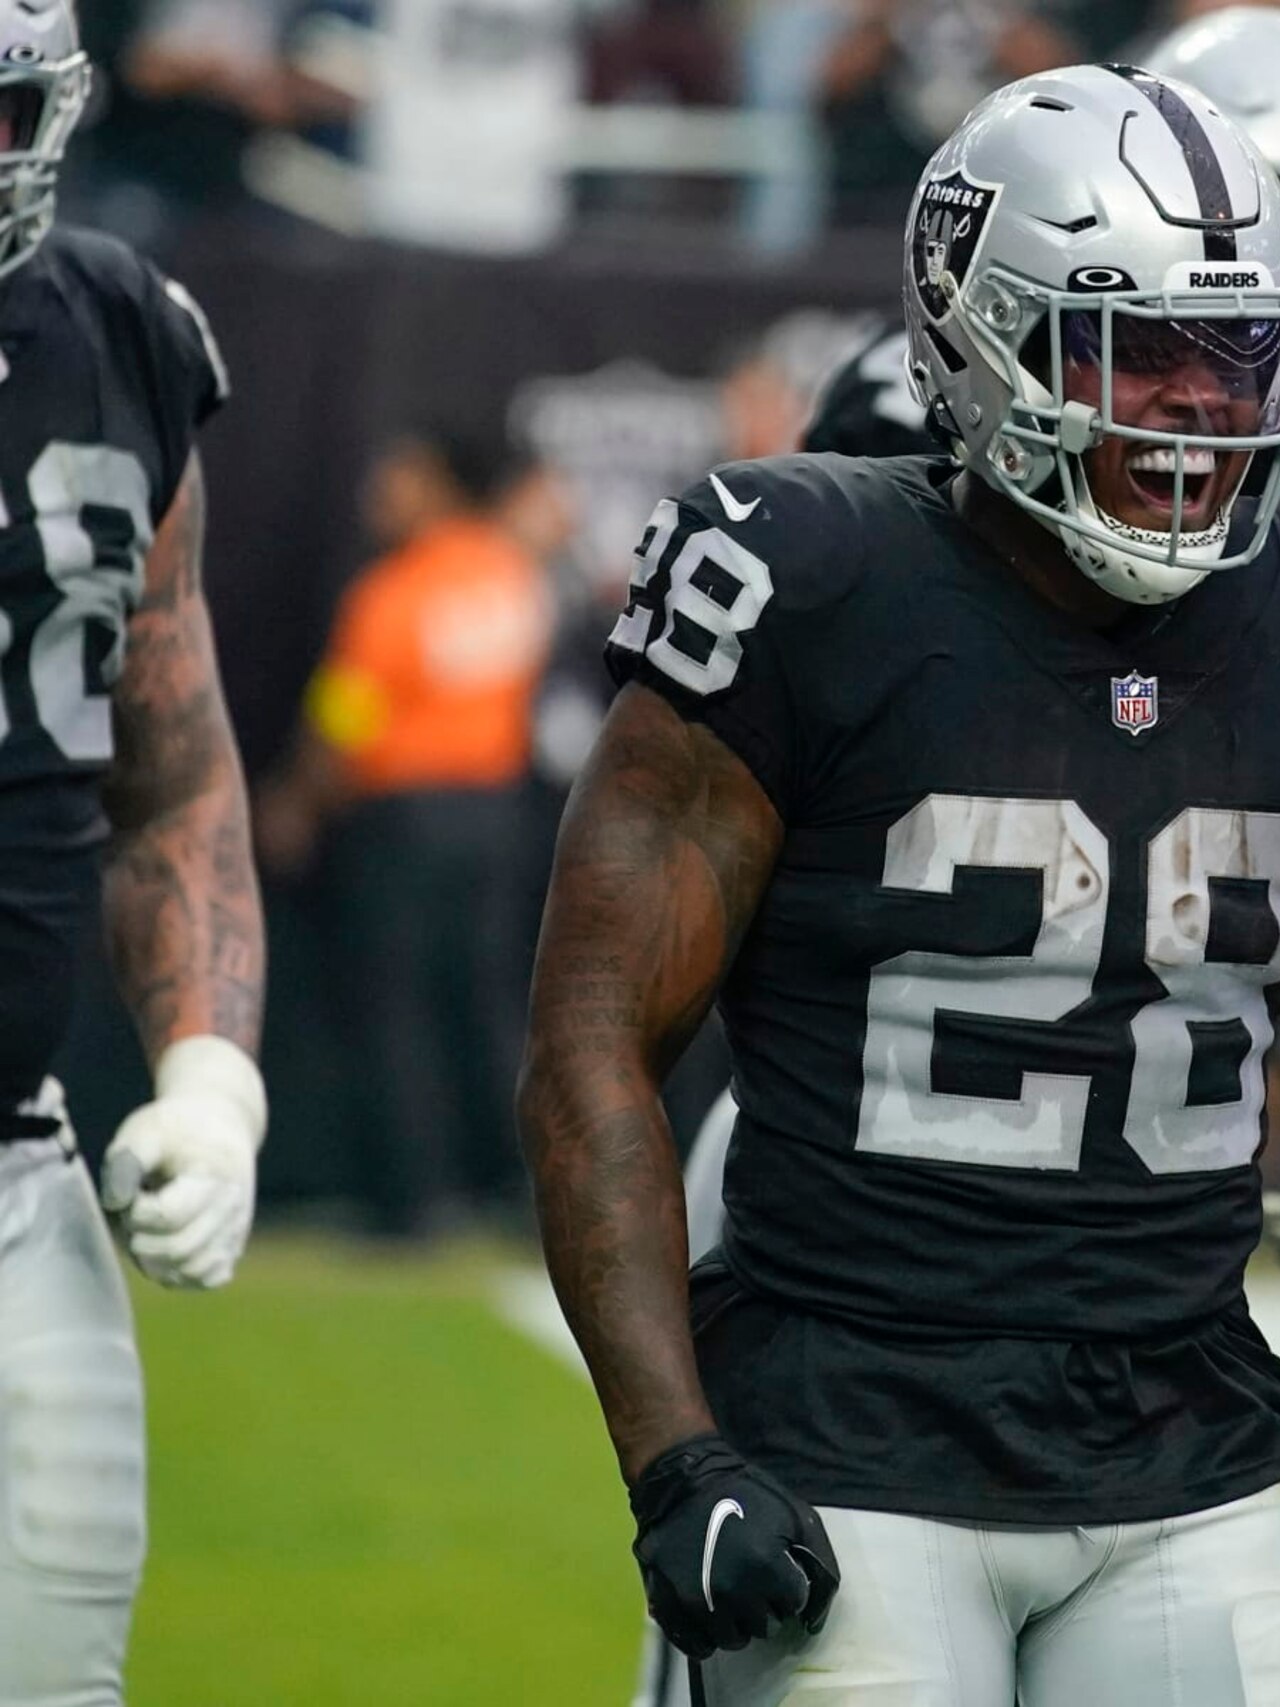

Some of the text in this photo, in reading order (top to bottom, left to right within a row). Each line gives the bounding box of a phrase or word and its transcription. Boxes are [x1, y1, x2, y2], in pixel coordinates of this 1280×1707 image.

[1189, 271, 1260, 288] RAIDERS
[0, 440, 154, 760] 8
[607, 499, 774, 696] 28
[1119, 699, 1151, 724] NFL
